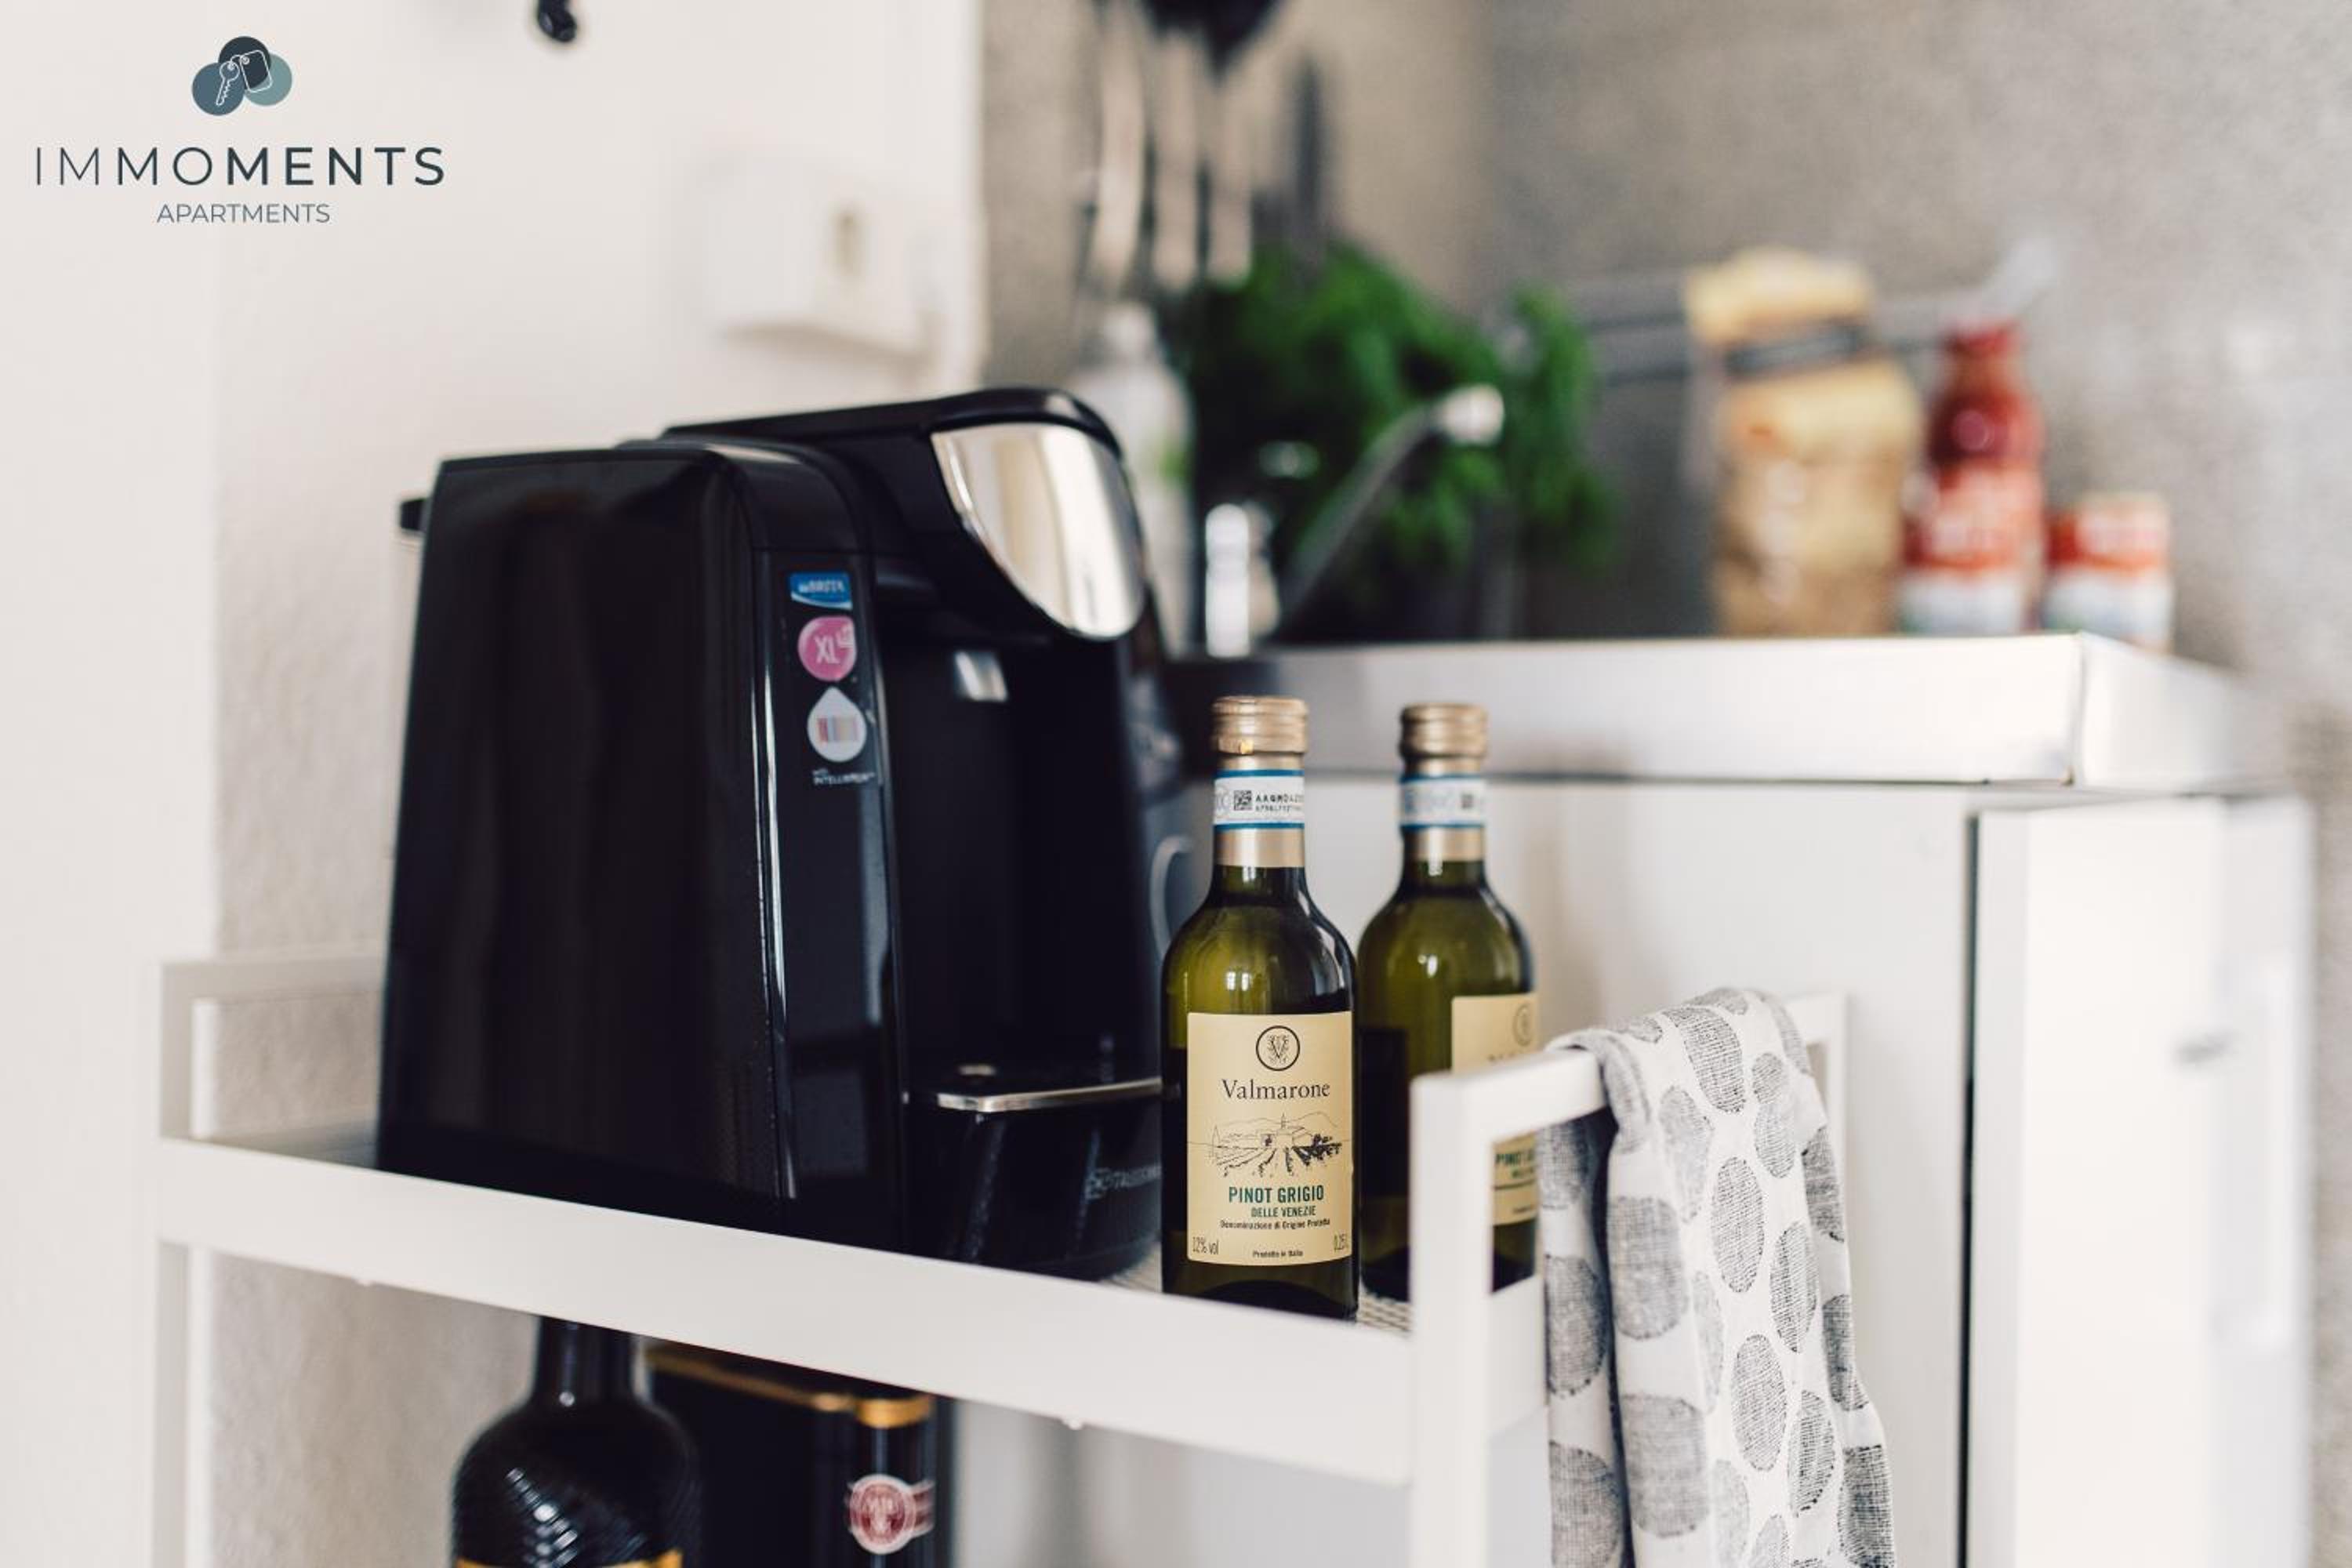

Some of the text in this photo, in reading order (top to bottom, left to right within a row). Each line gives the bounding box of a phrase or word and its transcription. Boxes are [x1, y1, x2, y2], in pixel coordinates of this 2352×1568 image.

[1221, 1078, 1330, 1099] Valmarone
[1229, 1185, 1324, 1203] PINOT GRIGIO
[1250, 1205, 1316, 1218] DELLE VENEZIE
